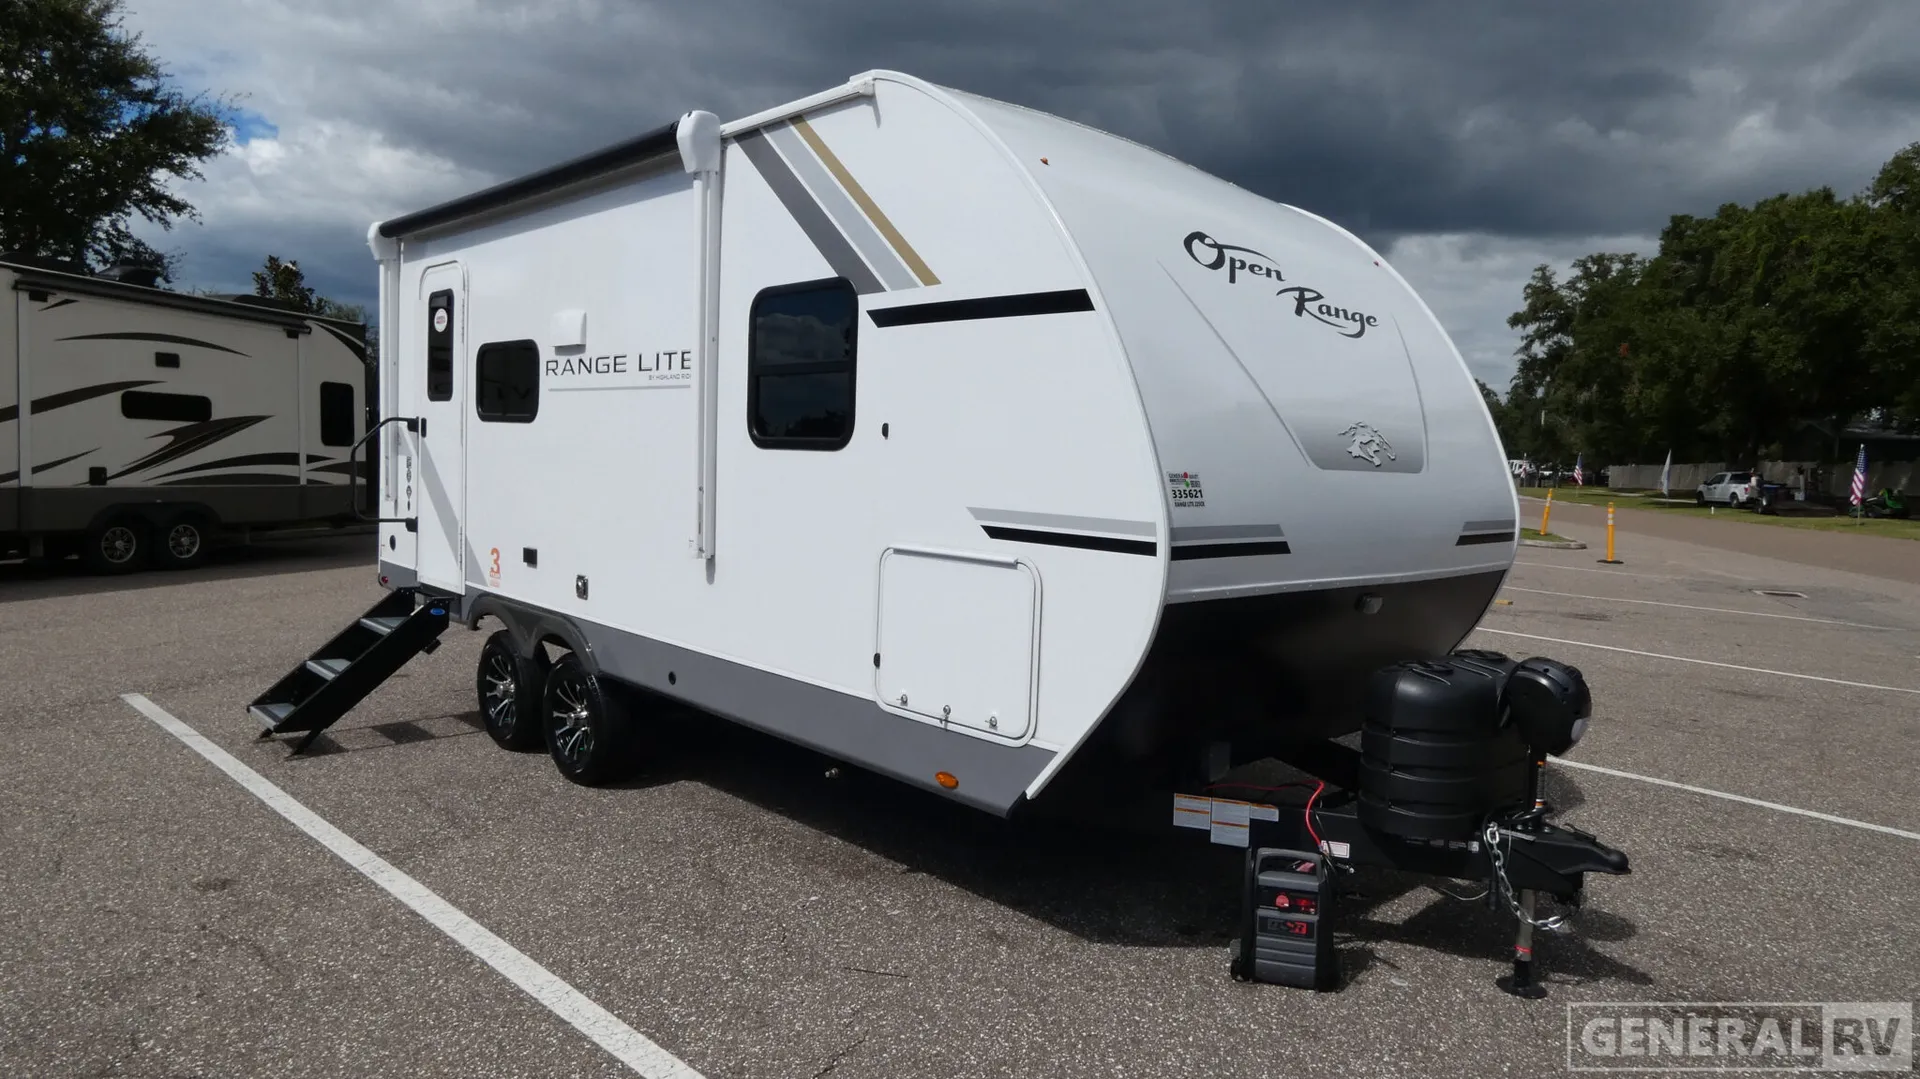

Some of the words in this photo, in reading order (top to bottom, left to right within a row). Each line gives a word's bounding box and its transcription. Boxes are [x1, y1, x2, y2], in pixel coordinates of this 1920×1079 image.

[1183, 231, 1286, 284] Open
[1276, 286, 1379, 338] Range
[546, 354, 627, 376] RANGE
[638, 350, 691, 372] LITE
[1172, 489, 1203, 499] 335621
[490, 547, 500, 574] 3
